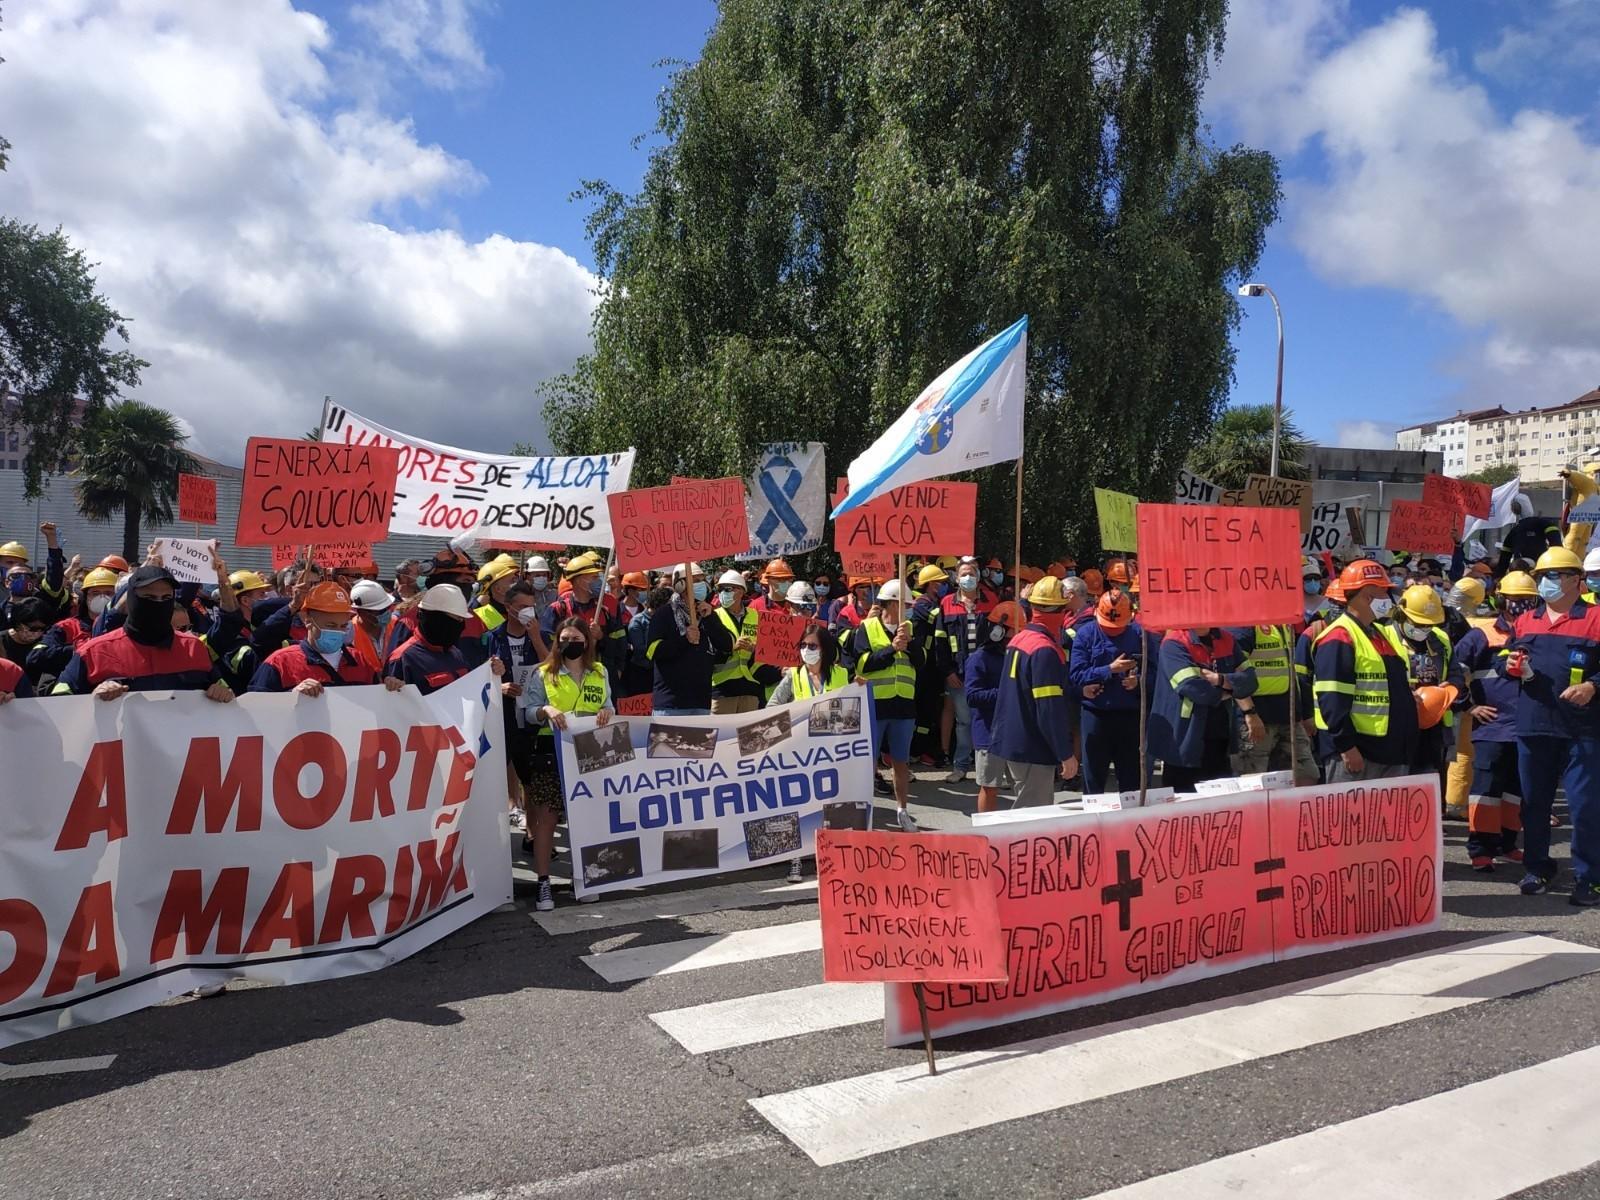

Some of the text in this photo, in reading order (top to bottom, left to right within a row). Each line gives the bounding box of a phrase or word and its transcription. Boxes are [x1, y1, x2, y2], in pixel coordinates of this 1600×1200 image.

[481, 464, 520, 488] DE
[621, 495, 637, 518] A
[889, 486, 950, 509] VENDE
[1223, 489, 1304, 507] SE VENDE
[418, 493, 478, 530] 1000
[848, 513, 936, 546] ALCOA
[1182, 516, 1264, 543] MESA
[171, 540, 209, 562] EU VOTO
[766, 544, 779, 556] SE
[172, 556, 199, 571] PECHE
[1148, 567, 1297, 593] ELECTORAL
[760, 612, 794, 625] ALCOA
[760, 626, 789, 639] CASA
[773, 639, 801, 650] VOLV
[583, 693, 602, 705] NON
[570, 739, 870, 801] A MARIÑA SÁLVASE
[54, 724, 476, 851] A MORTE
[608, 767, 840, 834] LOITANDO
[1135, 810, 1243, 883] XUNTA
[1297, 787, 1430, 852] ALUMINIO
[834, 844, 906, 873] TODOS
[911, 843, 988, 880] PROMETEN
[828, 878, 878, 908] PERO
[1175, 854, 1436, 940] DE PRIMARIO
[1125, 907, 1246, 984] GALICIA
